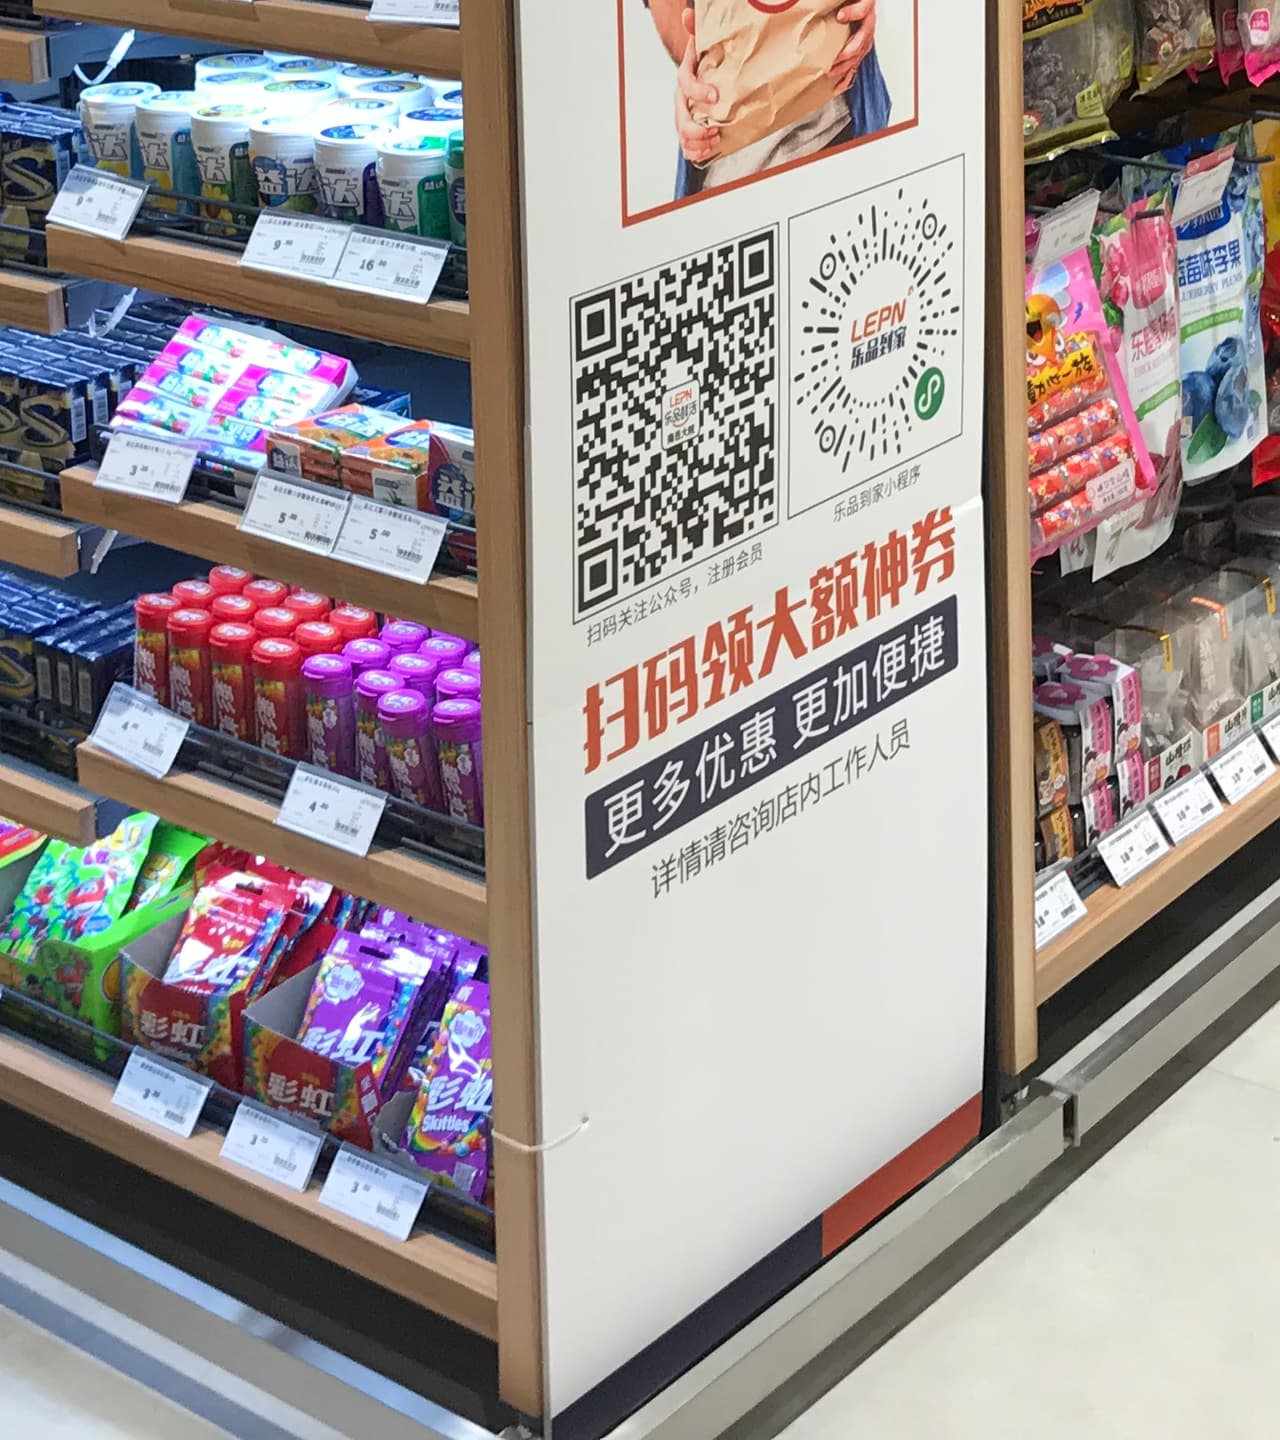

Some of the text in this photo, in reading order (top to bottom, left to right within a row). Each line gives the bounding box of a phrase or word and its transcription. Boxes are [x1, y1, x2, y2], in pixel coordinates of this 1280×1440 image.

[851, 299, 906, 344] LEPN
[851, 326, 907, 370] 乐品到家
[669, 388, 693, 408] LEPN
[832, 464, 921, 524] 乐品到家小程序
[582, 505, 956, 776] 扫码领大额神券
[603, 705, 778, 859] 更多优惠
[792, 614, 946, 751] 更加便捷
[650, 719, 911, 901] 详情请咨询店内工作人员
[422, 1114, 471, 1133] Skittles
